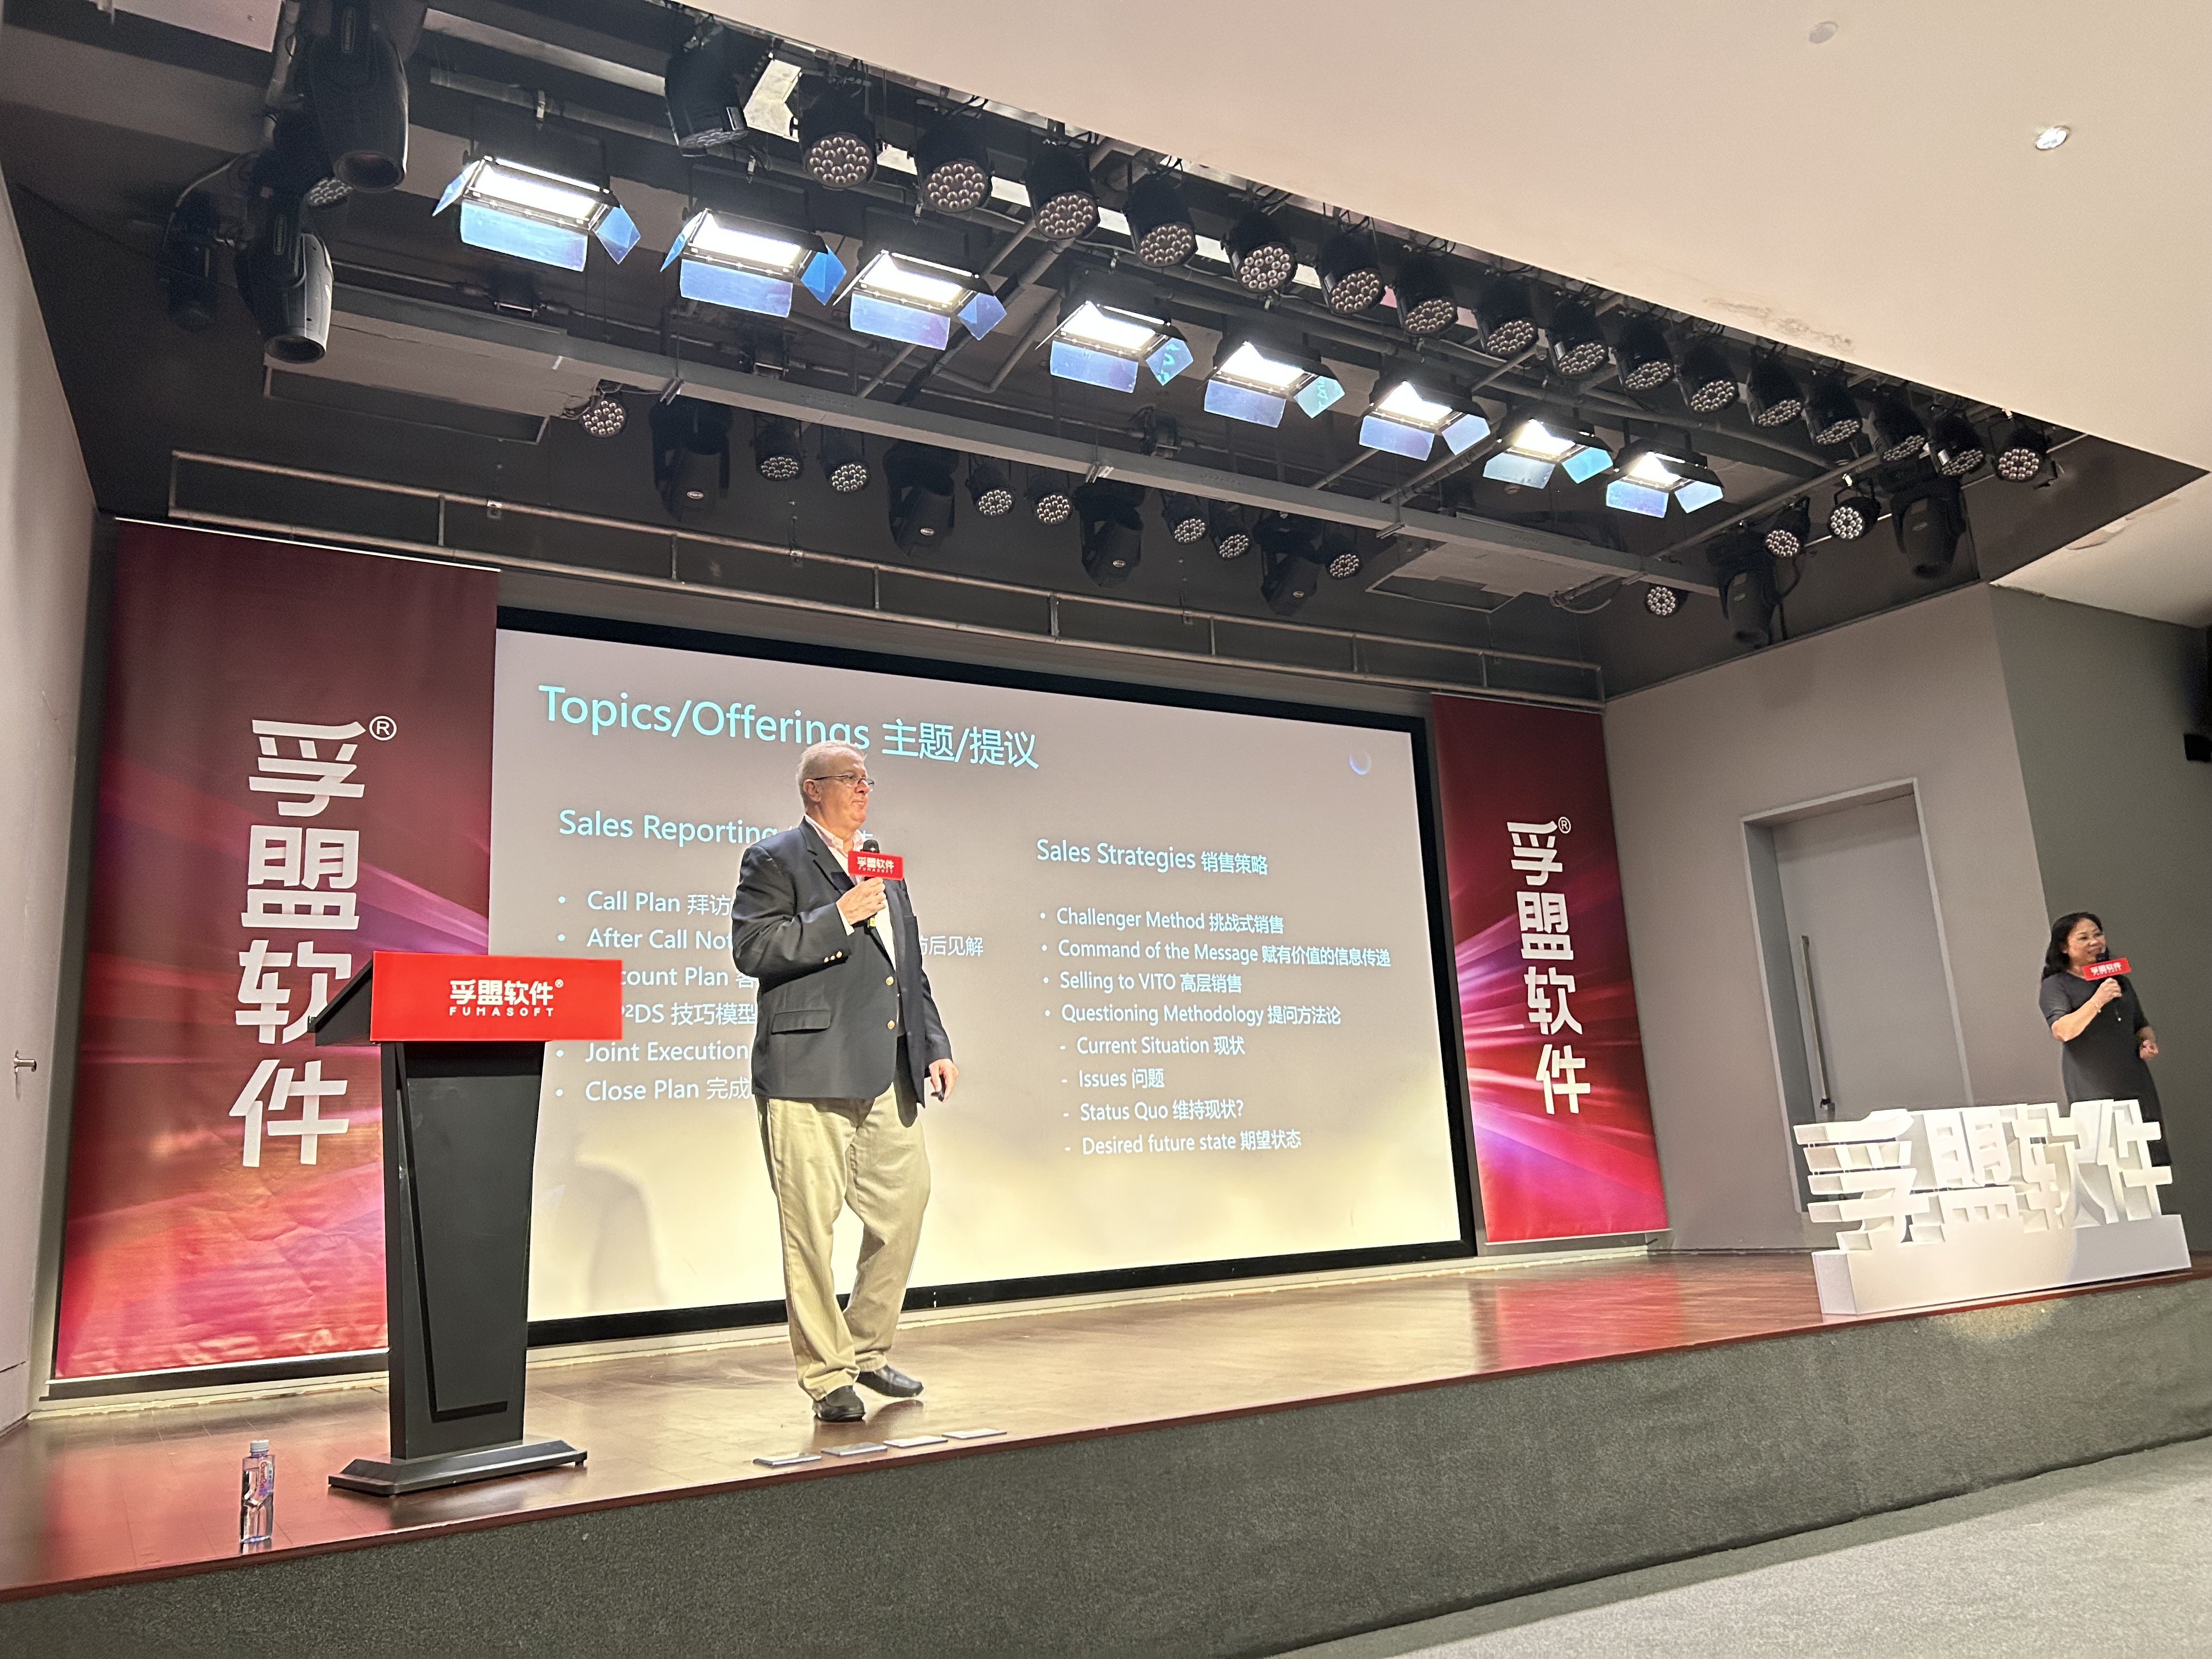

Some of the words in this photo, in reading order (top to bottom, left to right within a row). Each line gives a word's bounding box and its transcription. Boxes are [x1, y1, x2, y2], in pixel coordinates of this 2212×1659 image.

[538, 685, 870, 749] Topics/Offerings
[882, 718, 1039, 769] 主题/提议
[559, 809, 634, 838] Sales
[1036, 838, 1091, 863] Sales
[1096, 842, 1196, 873] Strategies
[1200, 850, 1268, 876] 销售策略
[587, 890, 627, 911] Call
[635, 891, 680, 912] Plan
[687, 894, 735, 916] 拜访
[1056, 907, 1142, 931] Challenger
[1146, 911, 1205, 930] Method
[1208, 912, 1284, 934] 挑战式销售
[586, 927, 643, 948] After
[648, 929, 687, 949] Call
[1058, 939, 1141, 959] Command
[1145, 941, 1161, 959] of
[1164, 942, 1190, 960] the
[1194, 944, 1259, 966] Message
[1261, 945, 1391, 967] 赋有价值的信息传递
[685, 966, 729, 986] Plan
[1060, 970, 1114, 994] Selling
[1118, 974, 1135, 990] to
[1138, 973, 1176, 991] VITO
[1180, 973, 1243, 994] 高层销售
[449, 1007, 554, 1017] FUMASOFT
[670, 1002, 758, 1026] 技巧模型
[1061, 1003, 1159, 1026] Questioning
[1163, 1005, 1264, 1026] Methodology
[1267, 1005, 1342, 1025] 提问方法论
[584, 1041, 640, 1063] Joint
[647, 1040, 748, 1061] Execution
[1076, 1036, 1137, 1054] Current
[1141, 1036, 1209, 1054] Situation
[1214, 1035, 1245, 1056] 现状
[585, 1080, 647, 1101] Close
[654, 1078, 699, 1099] Plan
[706, 1075, 751, 1100] 完成
[1079, 1070, 1127, 1088] Issues
[1131, 1068, 1165, 1089] 问题
[1080, 1103, 1130, 1121] Status
[1134, 1101, 1169, 1121] Quo
[1172, 1098, 1244, 1121] 维持现状?
[1082, 1134, 1143, 1155] Desired
[1148, 1133, 1195, 1153] future
[1199, 1133, 1237, 1151] state
[1239, 1128, 1302, 1151] 期望状态
[1793, 1099, 2173, 1251] 孚盟软件
